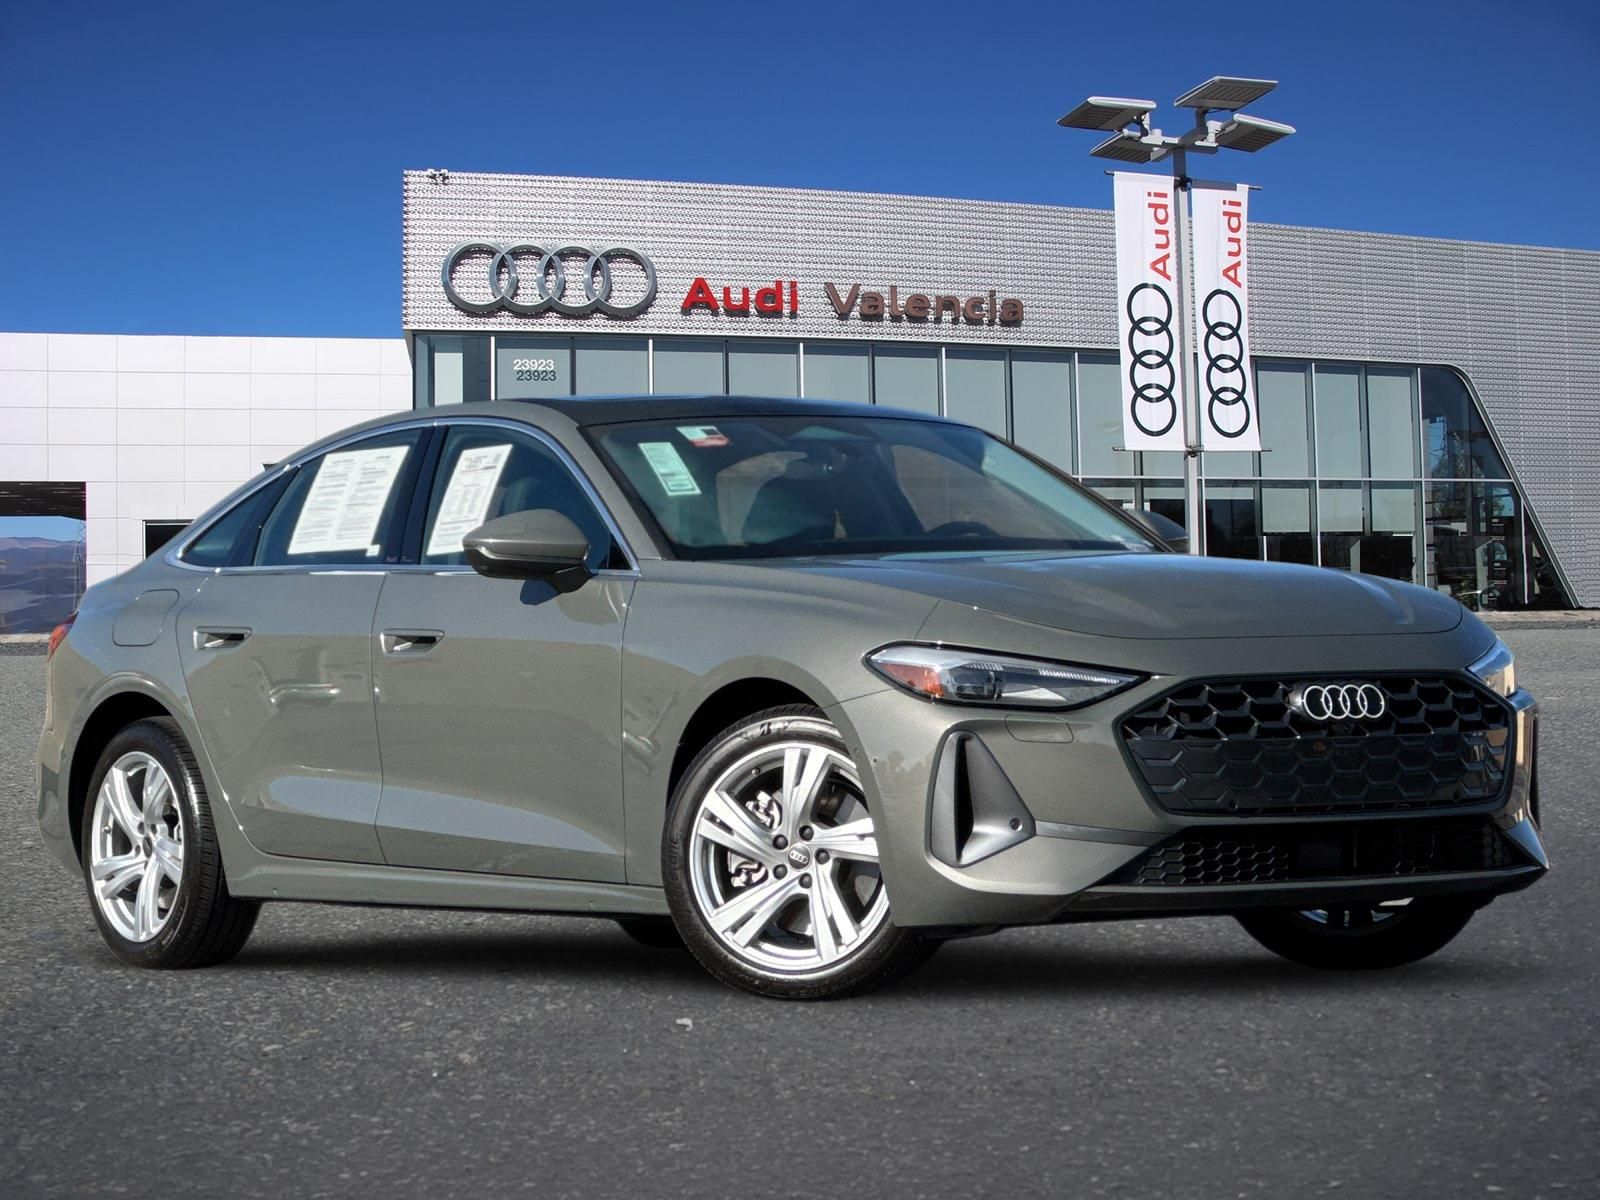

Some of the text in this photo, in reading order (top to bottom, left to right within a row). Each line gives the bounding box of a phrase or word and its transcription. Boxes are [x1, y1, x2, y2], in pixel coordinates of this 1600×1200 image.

[1147, 191, 1171, 282] Audi
[1222, 199, 1242, 289] Audi
[682, 277, 1023, 324] Audi Valencia
[513, 358, 554, 371] 23923
[516, 369, 557, 381] 23923
